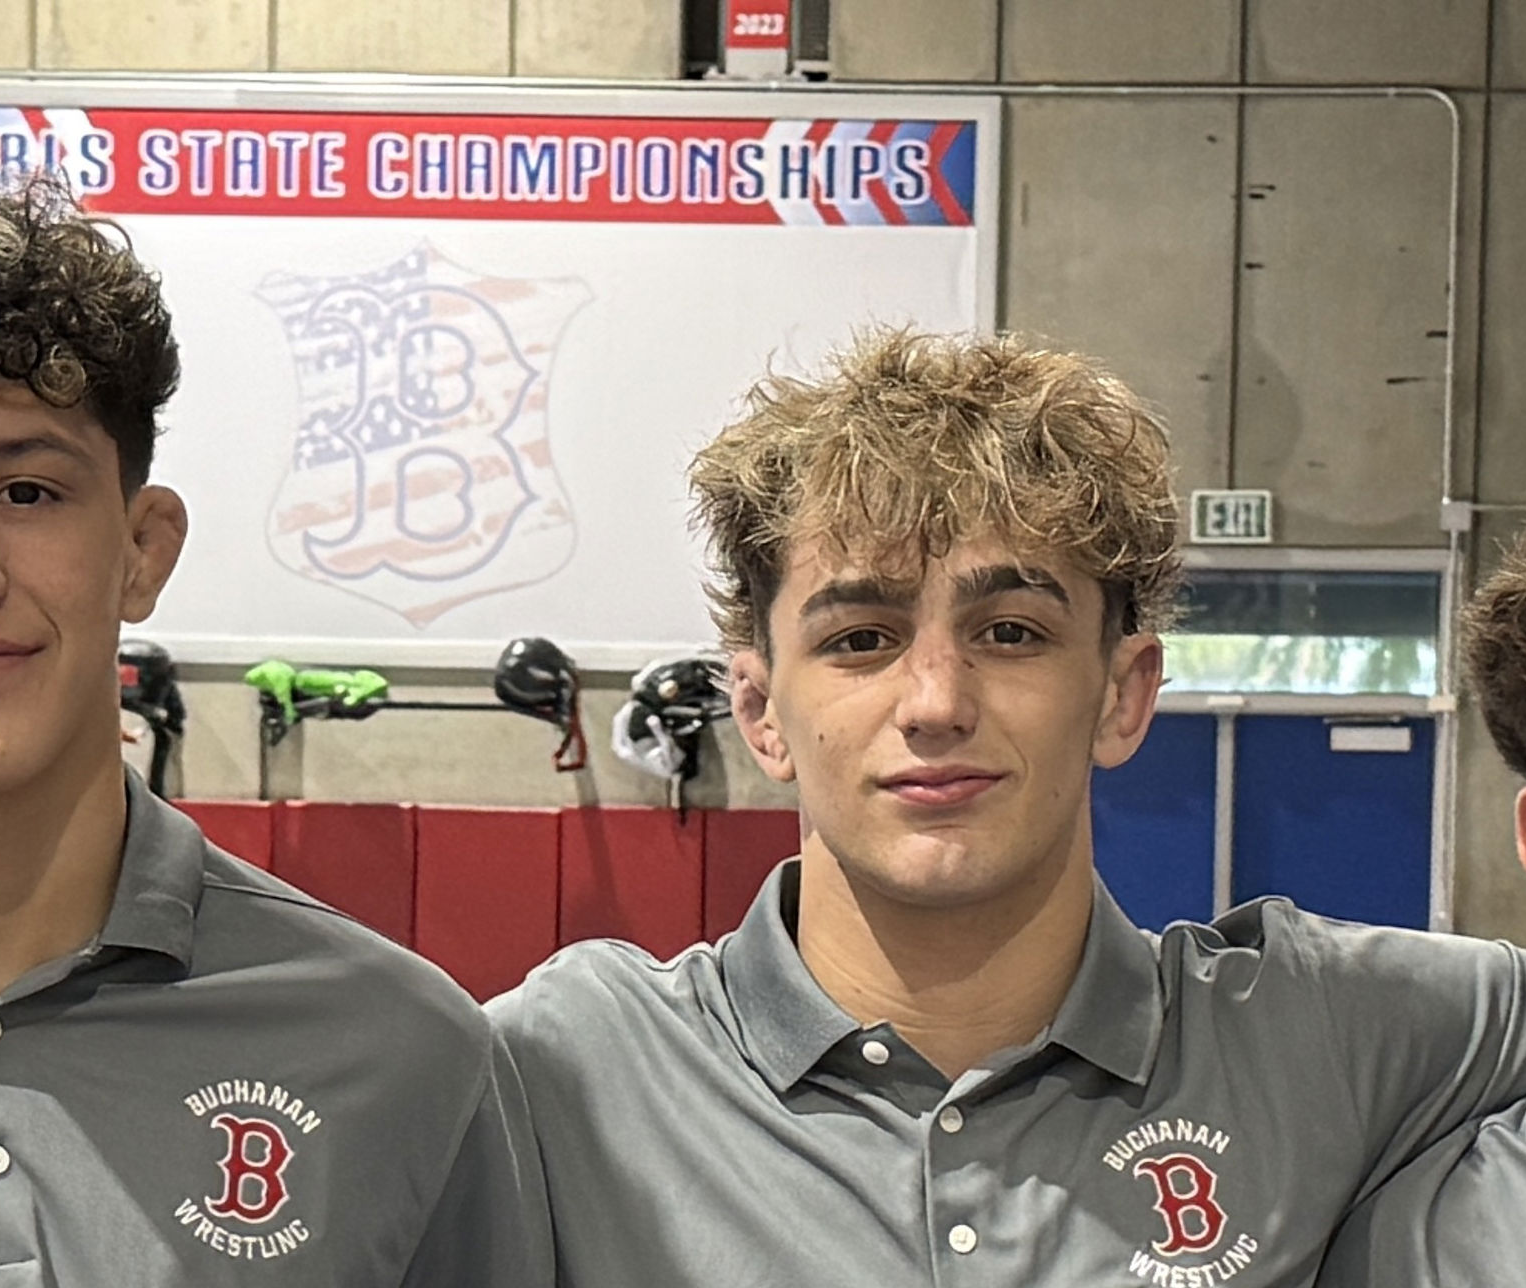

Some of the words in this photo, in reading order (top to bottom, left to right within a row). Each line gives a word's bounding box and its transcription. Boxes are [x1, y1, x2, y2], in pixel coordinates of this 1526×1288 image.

[138, 128, 347, 198] STATE
[366, 131, 934, 206] CHAMPIONSHIPS
[303, 284, 541, 584] B
[1205, 498, 1263, 535] EXIT
[183, 1078, 322, 1135] BUCHANAN
[204, 1112, 296, 1224] B
[1102, 1118, 1231, 1172] BUCHANAN
[173, 1197, 311, 1260] WRESTLING
[1133, 1153, 1230, 1258] B
